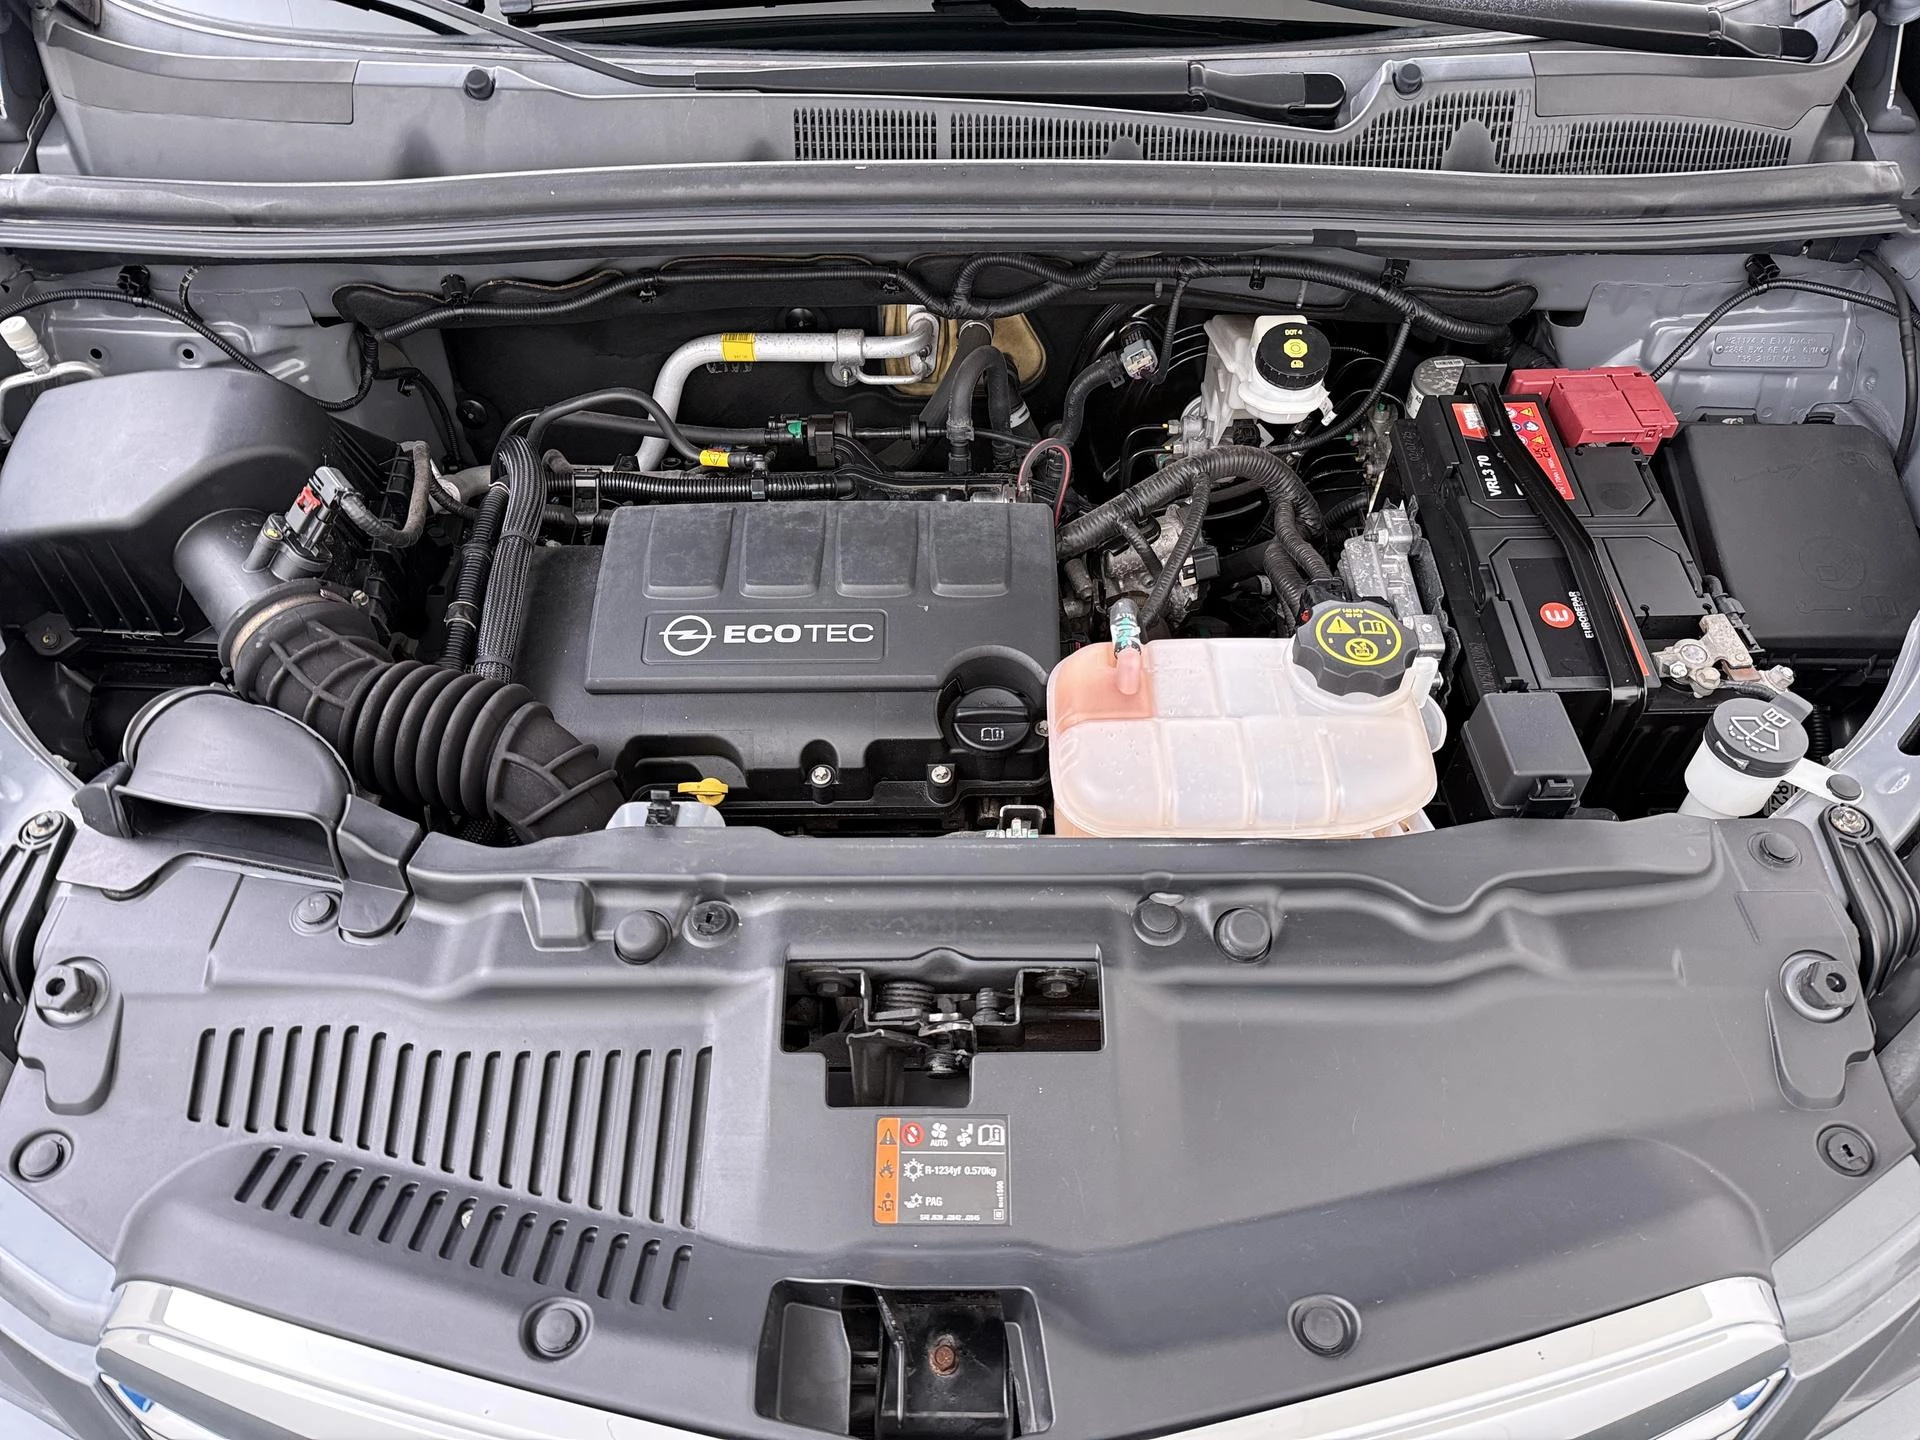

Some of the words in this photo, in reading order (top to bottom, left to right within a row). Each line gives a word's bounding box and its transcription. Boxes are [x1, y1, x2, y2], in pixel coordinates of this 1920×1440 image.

[1476, 454, 1492, 468] 70
[1481, 468, 1502, 497] VRL3
[723, 623, 874, 643] ECOTEC
[930, 1139, 948, 1147] AUTO
[924, 1165, 962, 1177] R-1234yf
[964, 1165, 997, 1177] 0.570kg
[925, 1196, 943, 1207] PAG
